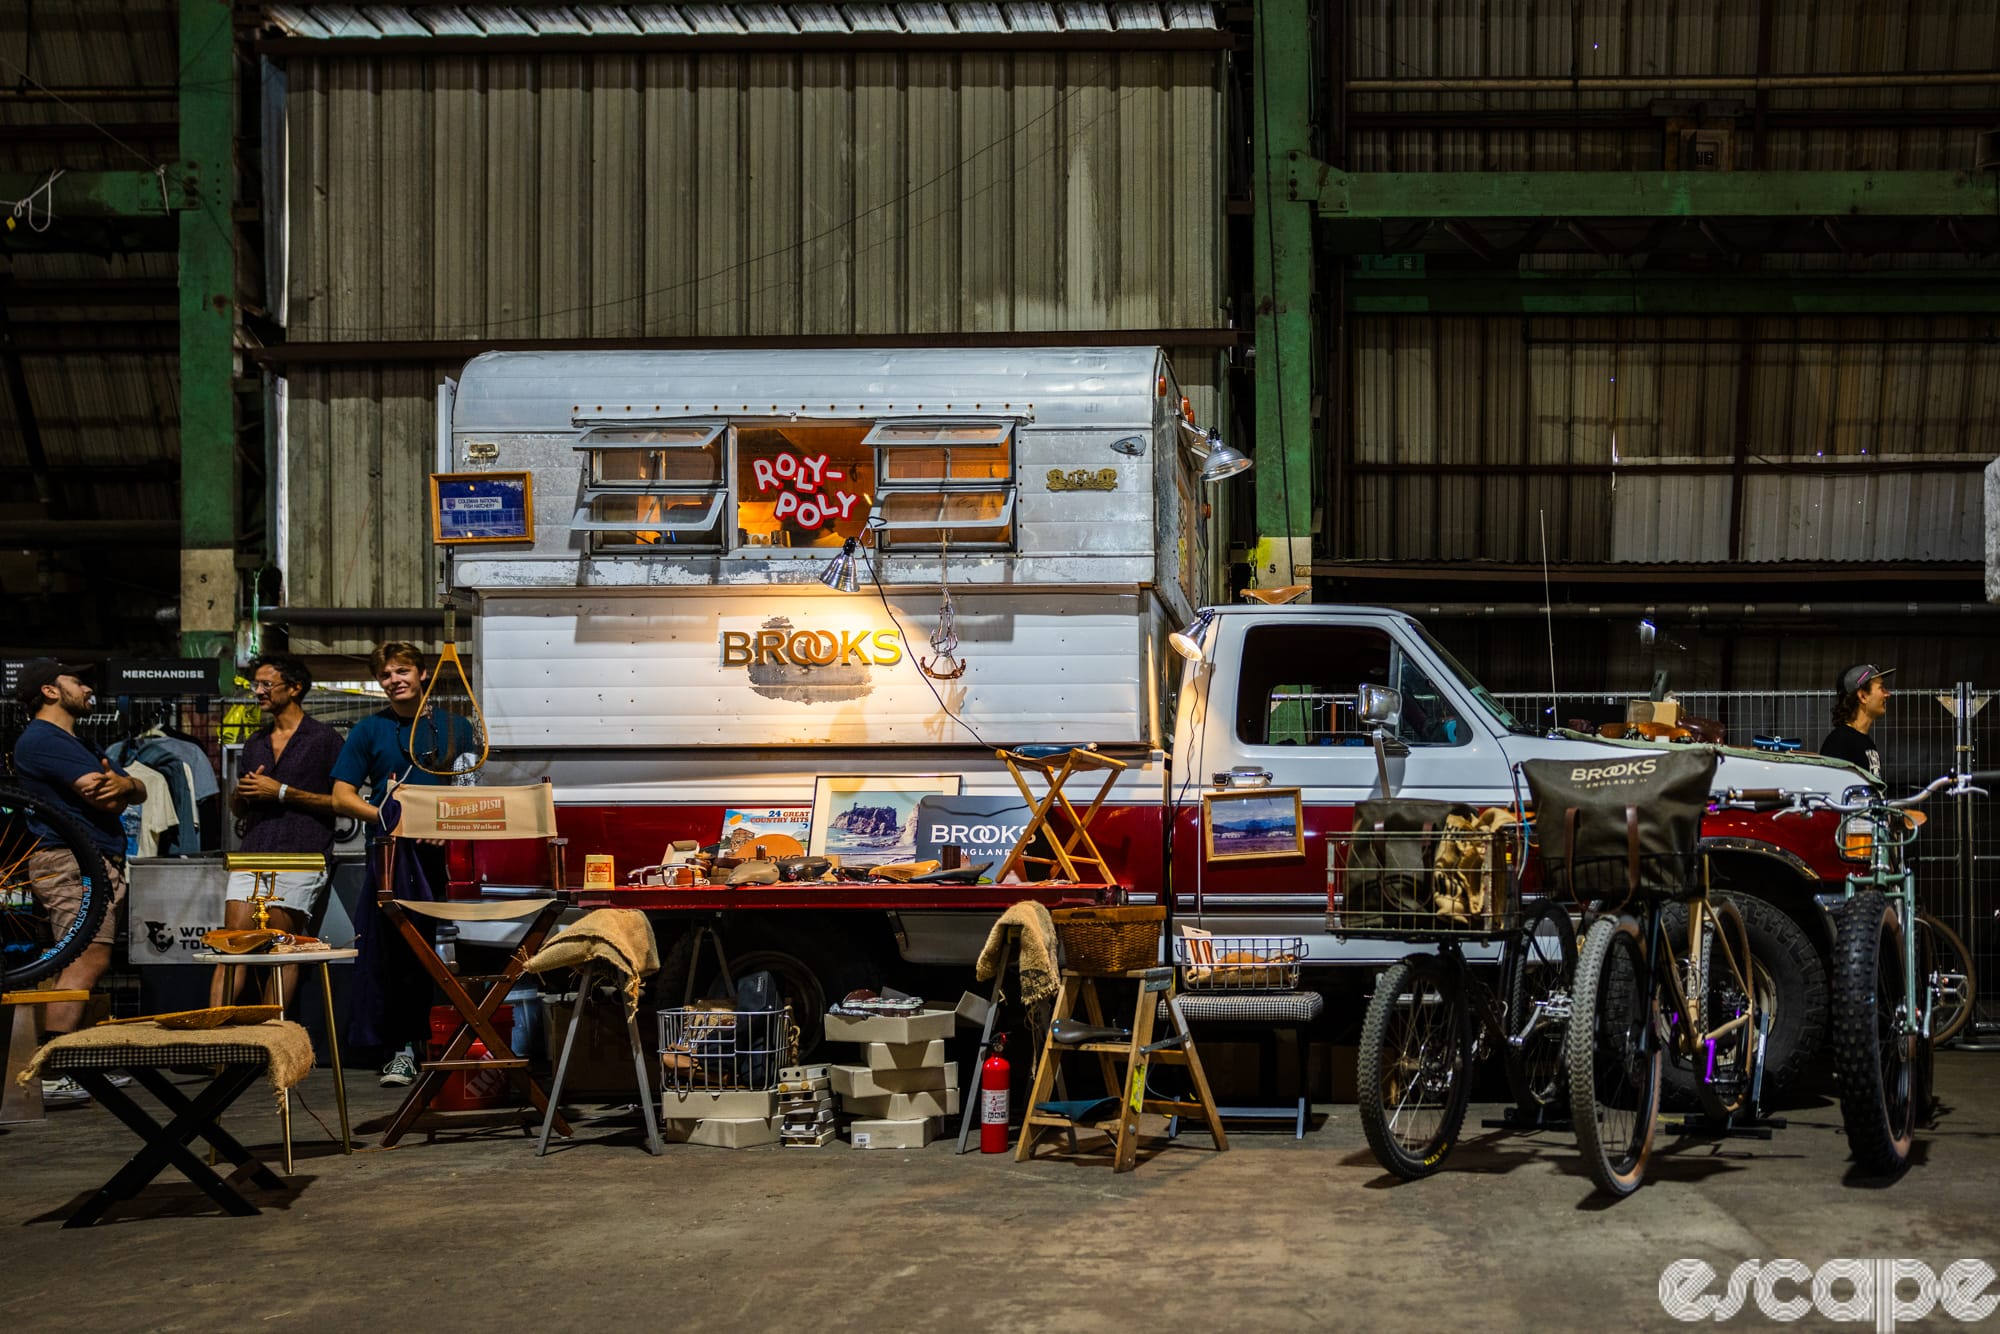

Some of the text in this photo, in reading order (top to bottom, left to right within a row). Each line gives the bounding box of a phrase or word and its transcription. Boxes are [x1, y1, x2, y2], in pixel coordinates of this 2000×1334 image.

[753, 453, 844, 492] ROLY-
[775, 490, 859, 528] POLY
[722, 630, 902, 666] BROOKS
[122, 670, 205, 678] MERCHANDISE
[1570, 759, 1657, 781] BROOKS
[1585, 779, 1635, 789] ENGLAND
[439, 799, 501, 818] DEEPER DISH
[960, 848, 1014, 856] NGLAND
